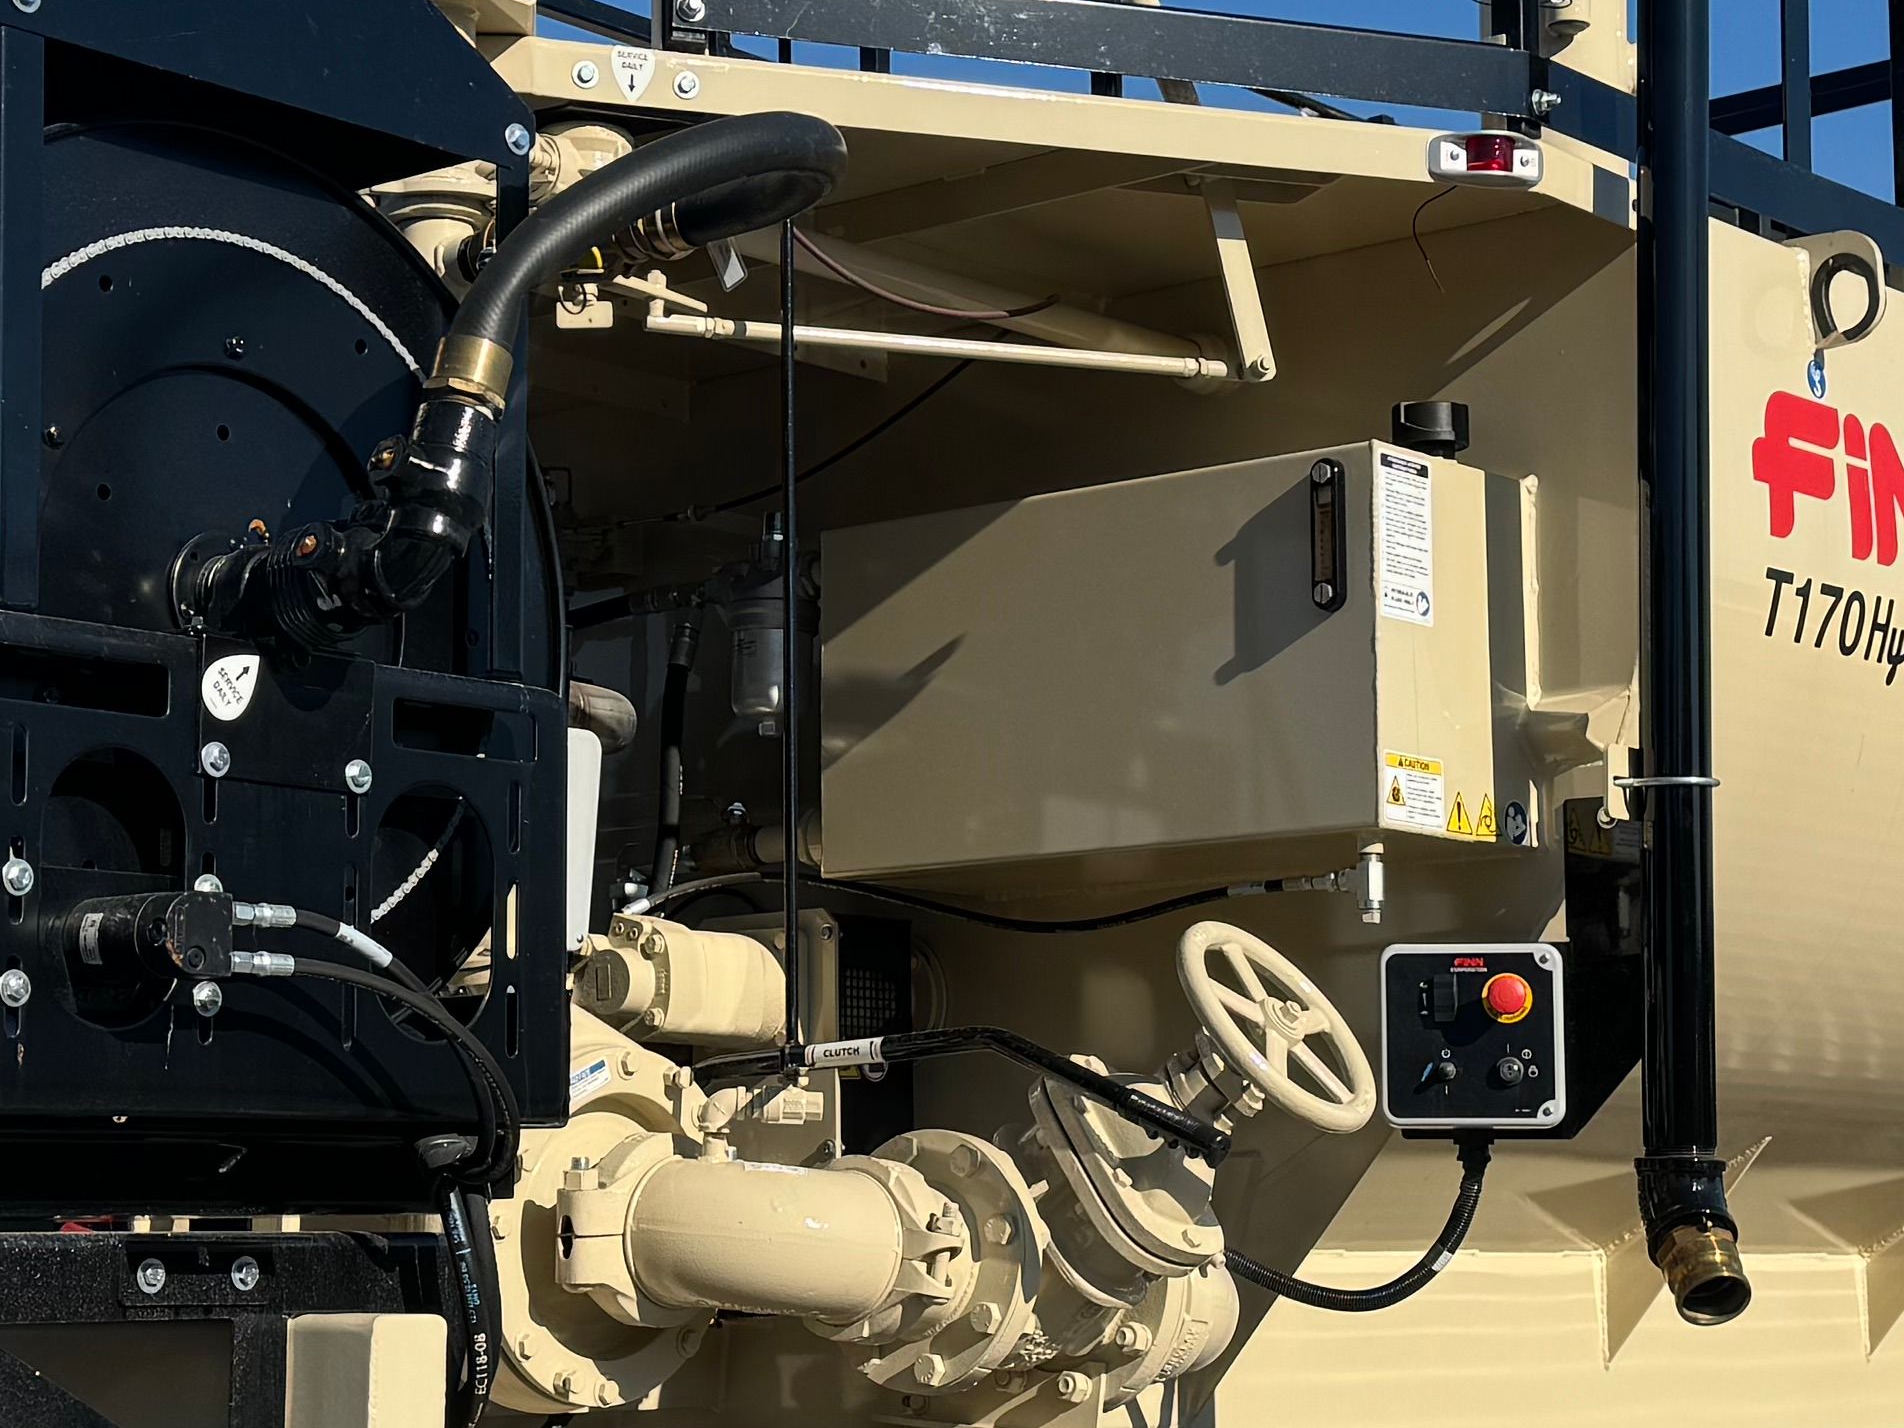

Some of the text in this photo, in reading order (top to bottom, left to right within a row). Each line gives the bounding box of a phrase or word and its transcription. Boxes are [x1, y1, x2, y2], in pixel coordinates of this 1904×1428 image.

[1764, 566, 1866, 657] T170
[1404, 758, 1430, 771] CAUTION
[823, 1046, 861, 1058] CLUTCH
